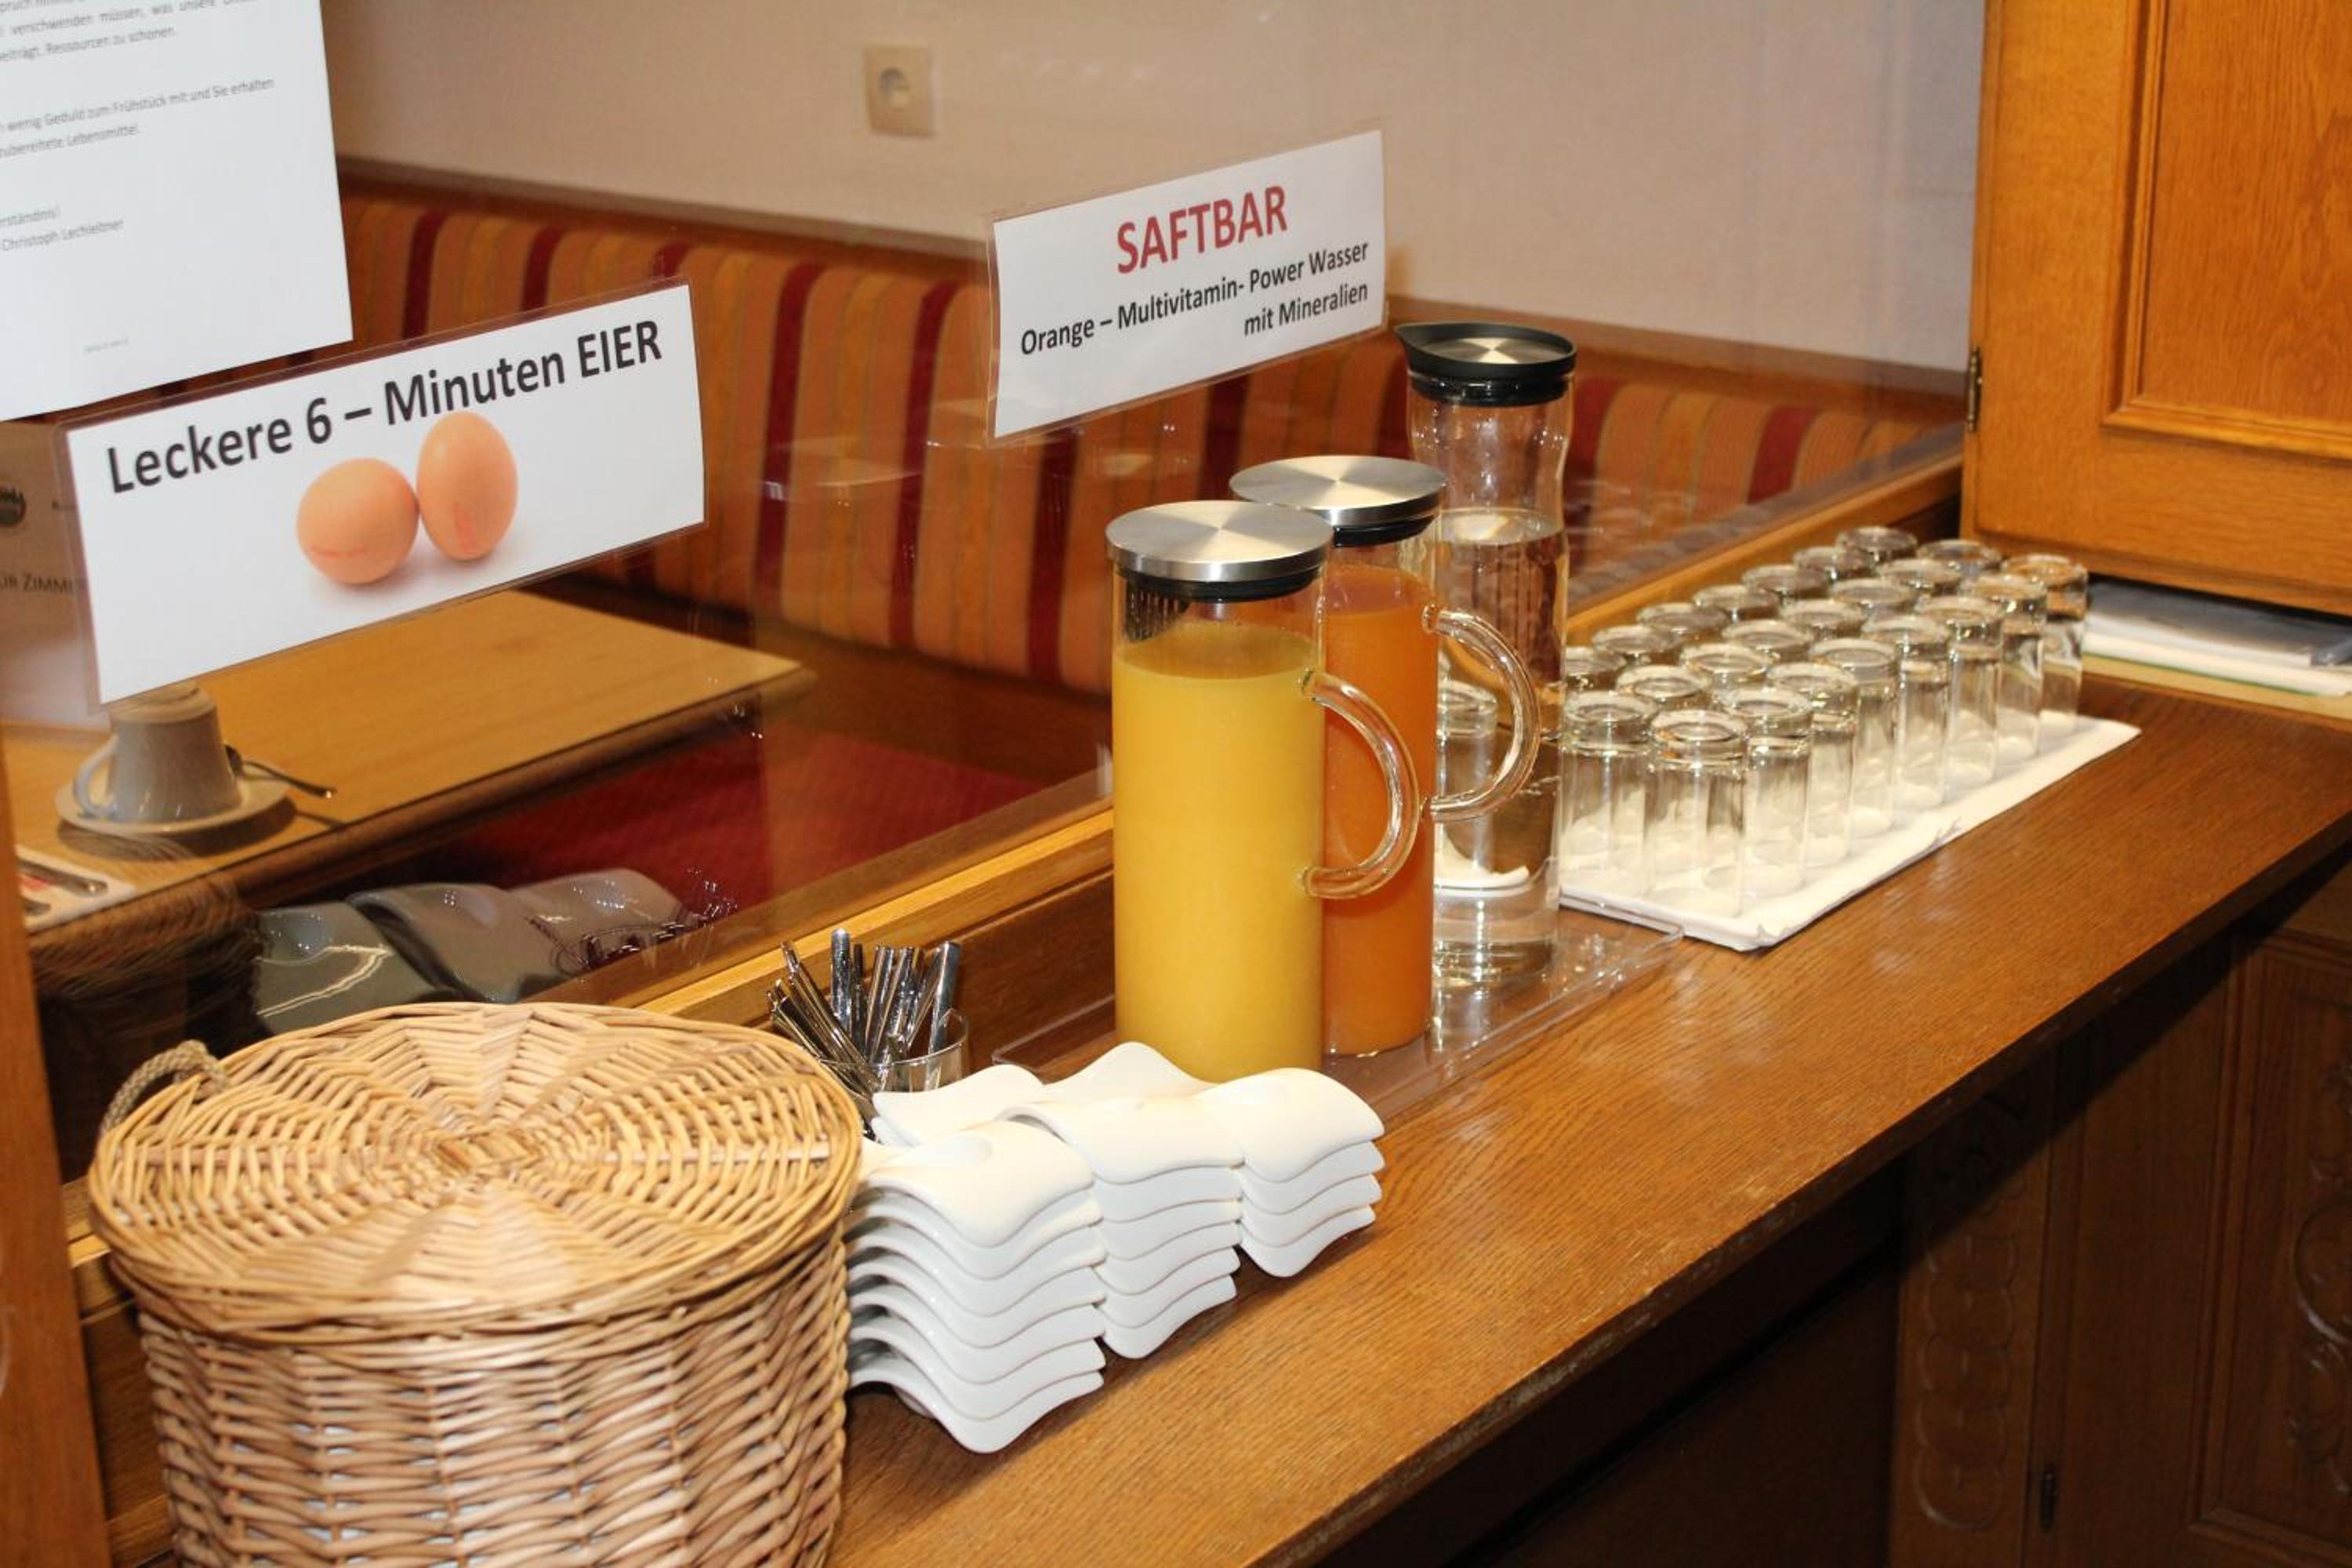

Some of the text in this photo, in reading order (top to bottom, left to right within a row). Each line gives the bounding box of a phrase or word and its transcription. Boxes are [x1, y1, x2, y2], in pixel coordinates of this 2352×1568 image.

[1118, 186, 1287, 274] SAFTBAR
[1022, 318, 1094, 355] Orange
[1118, 277, 1244, 329] Multivitamin-
[1250, 260, 1305, 292] Power
[1309, 243, 1368, 275] Wasser
[1244, 283, 1368, 336] mit Mineralien
[107, 418, 292, 493] Leckere
[307, 397, 332, 445] 6
[384, 352, 564, 426] Minuten
[577, 321, 662, 378] EIER
